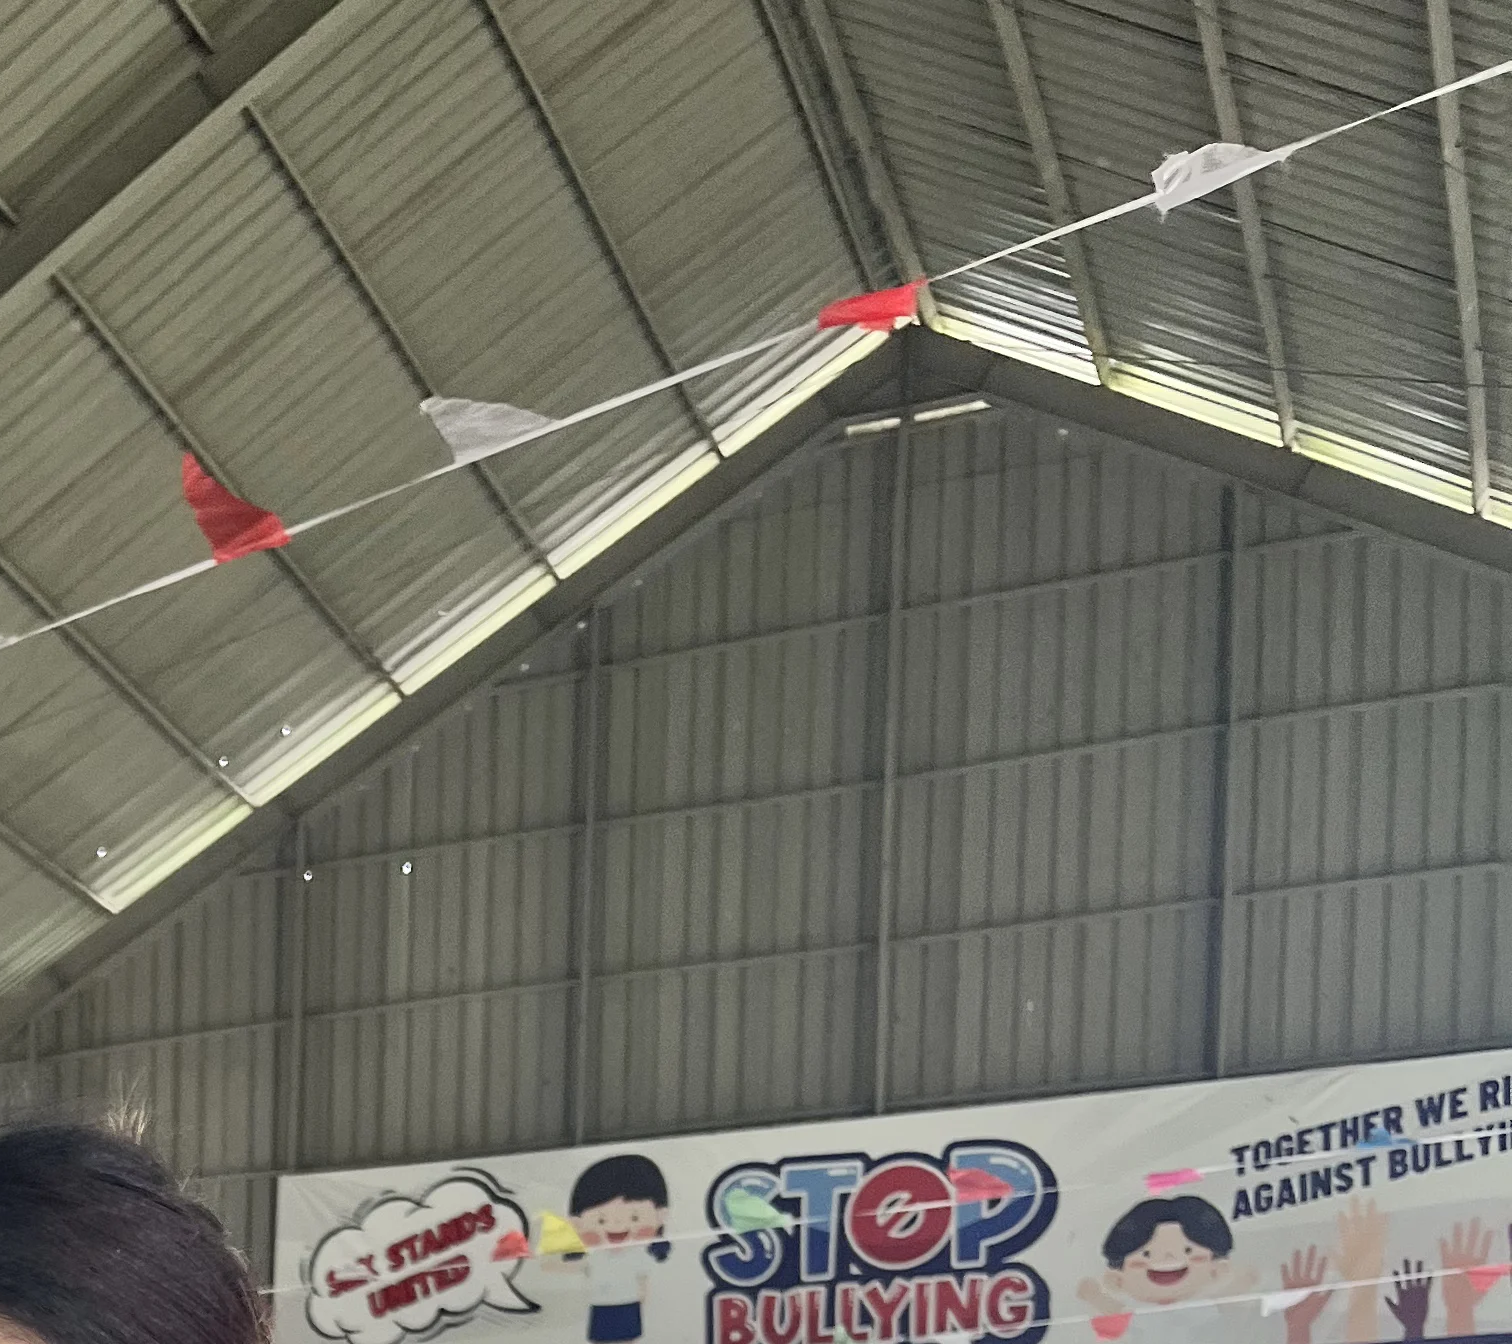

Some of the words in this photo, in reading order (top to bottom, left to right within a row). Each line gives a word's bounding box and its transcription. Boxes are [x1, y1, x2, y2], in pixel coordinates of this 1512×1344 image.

[1230, 1105, 1404, 1176] TOGETHER
[1415, 1087, 1468, 1127] WE
[1232, 1155, 1377, 1220] AGAINST
[1388, 1119, 1512, 1180] BULLYI
[386, 1203, 496, 1272] STANDS
[709, 1146, 1044, 1286] STOP
[367, 1254, 471, 1319] UNITED
